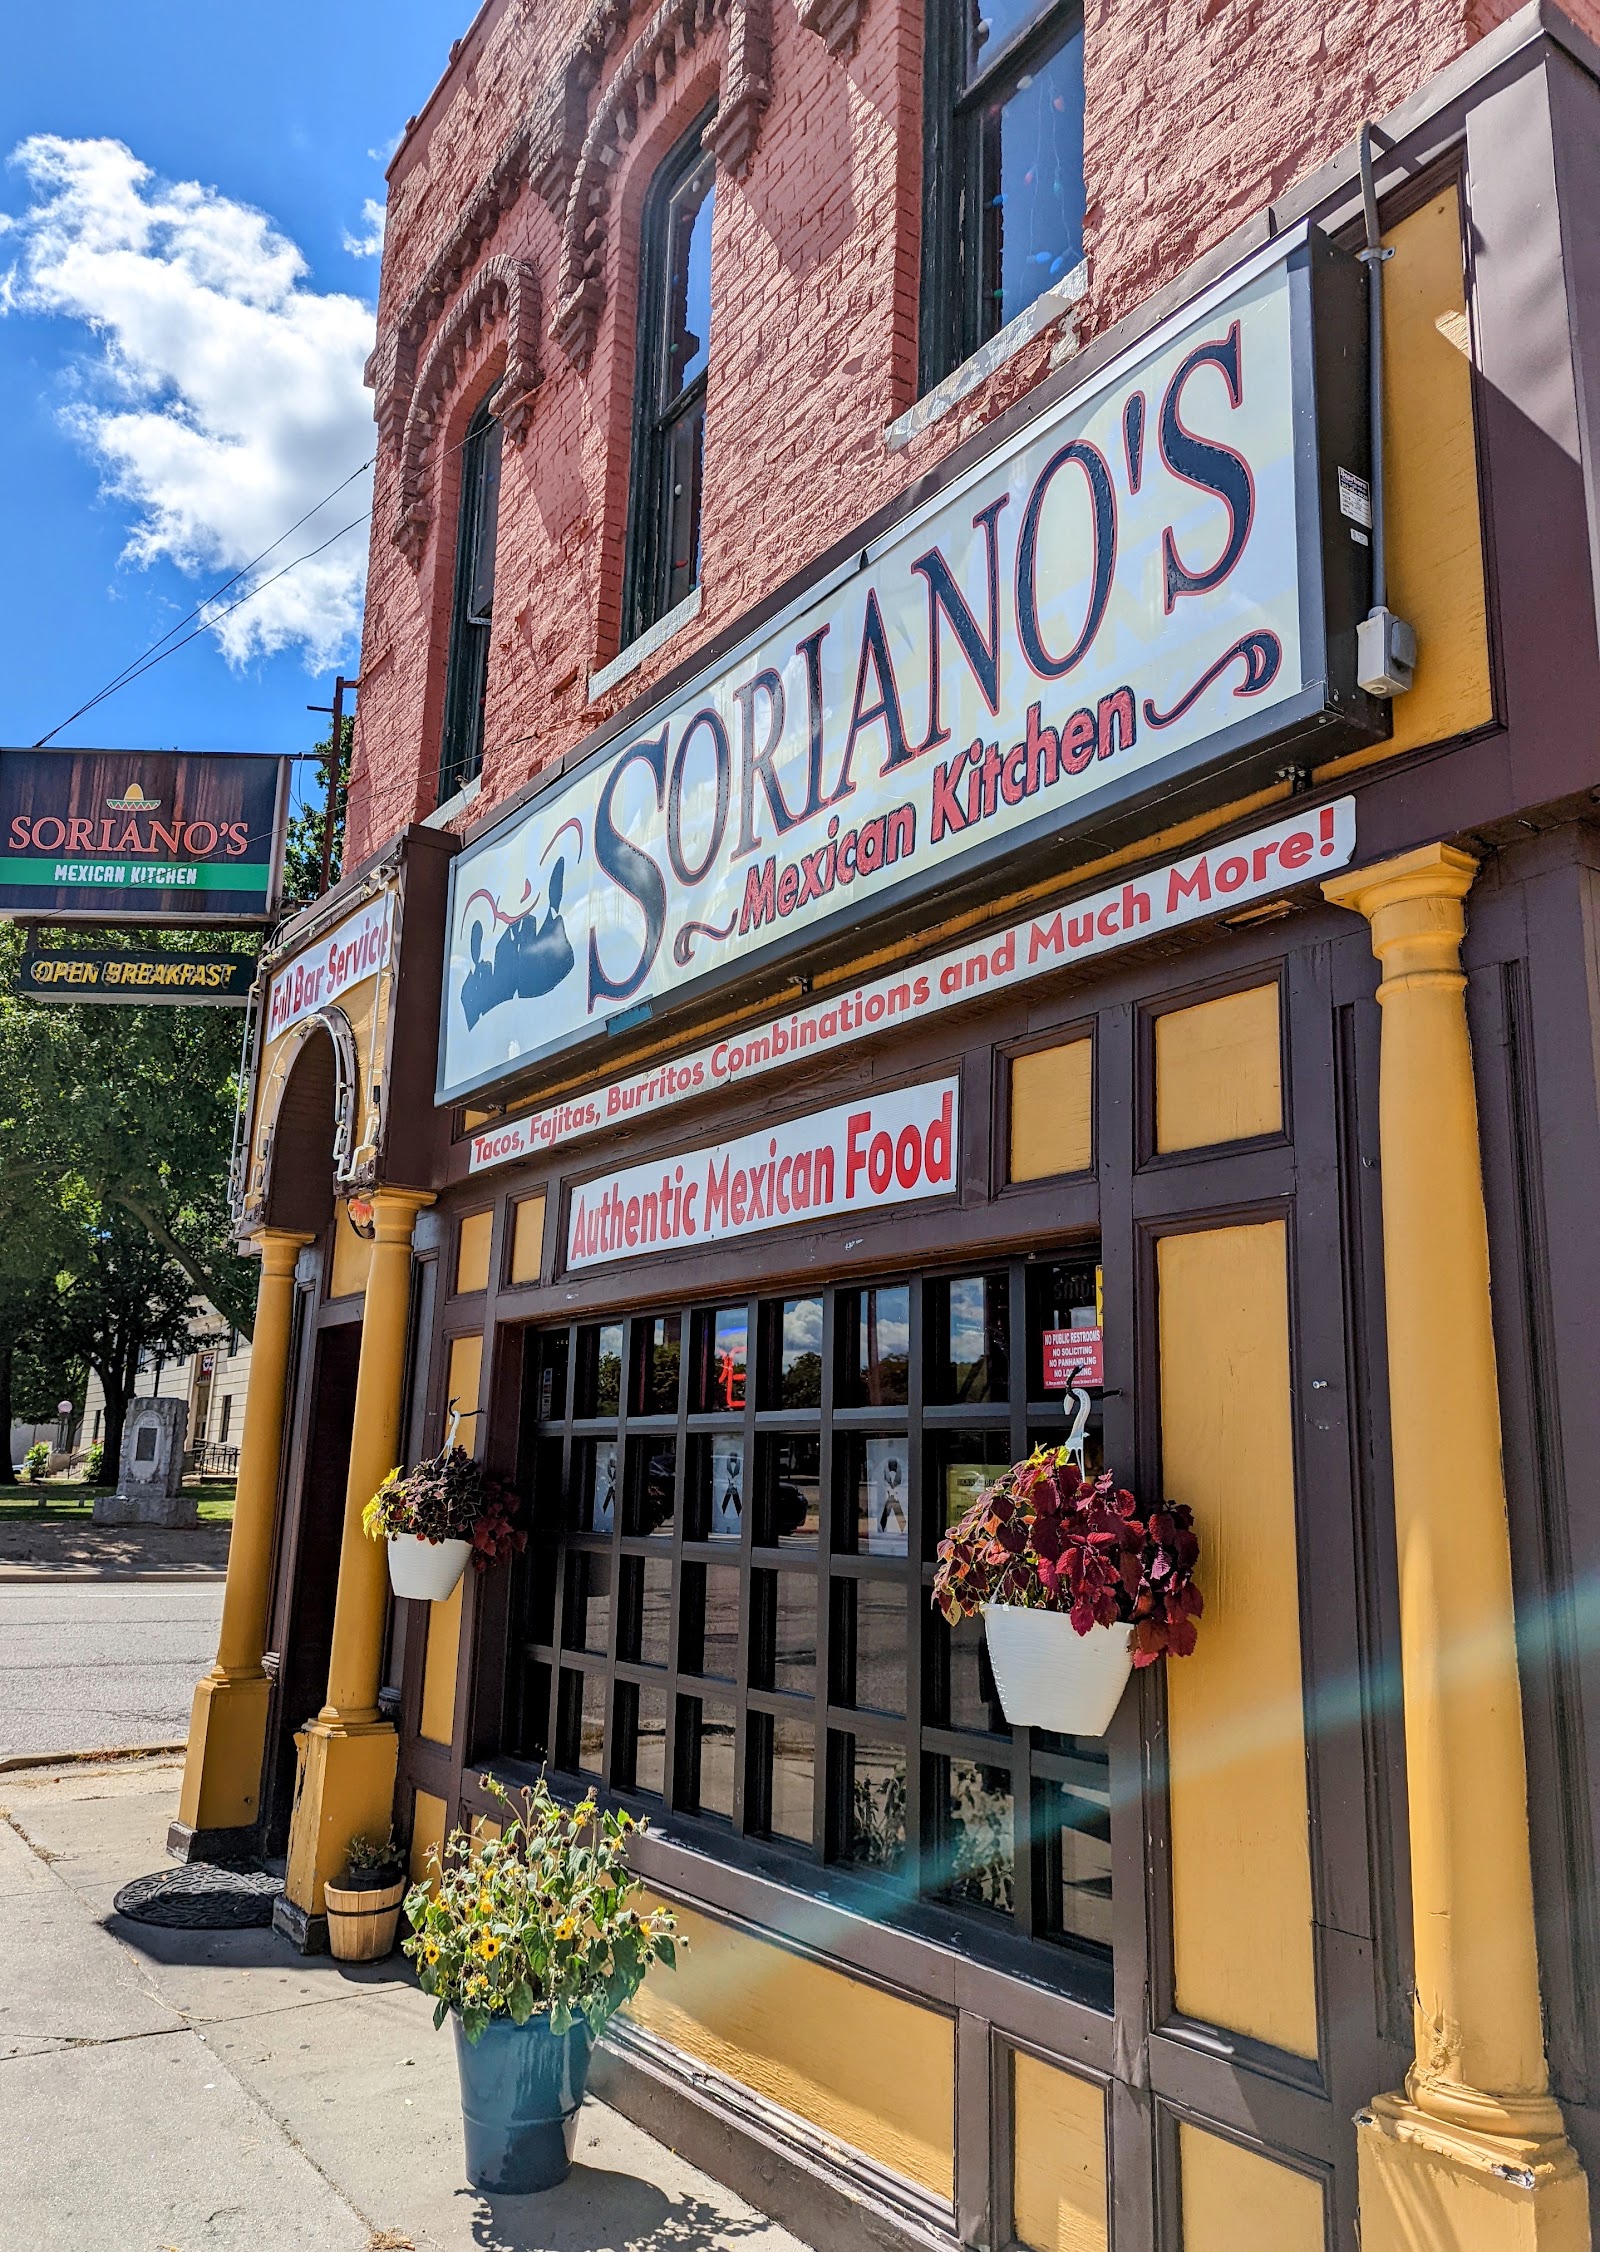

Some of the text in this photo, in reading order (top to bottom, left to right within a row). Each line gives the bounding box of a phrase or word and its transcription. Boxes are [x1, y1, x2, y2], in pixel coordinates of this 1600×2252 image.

[587, 319, 1256, 1015] SORIANO'S
[738, 684, 1138, 937] Mexican Kitchen
[8, 814, 249, 857] SORIANO'S
[54, 864, 197, 886] MEXICAN KITCHEN
[33, 961, 237, 987] OPEN BREAKFAST
[271, 916, 389, 1033] Full Bar Service
[474, 807, 1335, 1165] Tacos, Fajitas, Burritos Combinations and Much More!
[571, 1091, 953, 1260] Authentic Mexican Food
[1045, 1330, 1100, 1346] NO PUBLIC RESTROOMS
[1053, 1346, 1093, 1357] NO SOLICITING
[1049, 1356, 1097, 1368] NO PANHANDLING
[1054, 1369, 1062, 1378] NO
